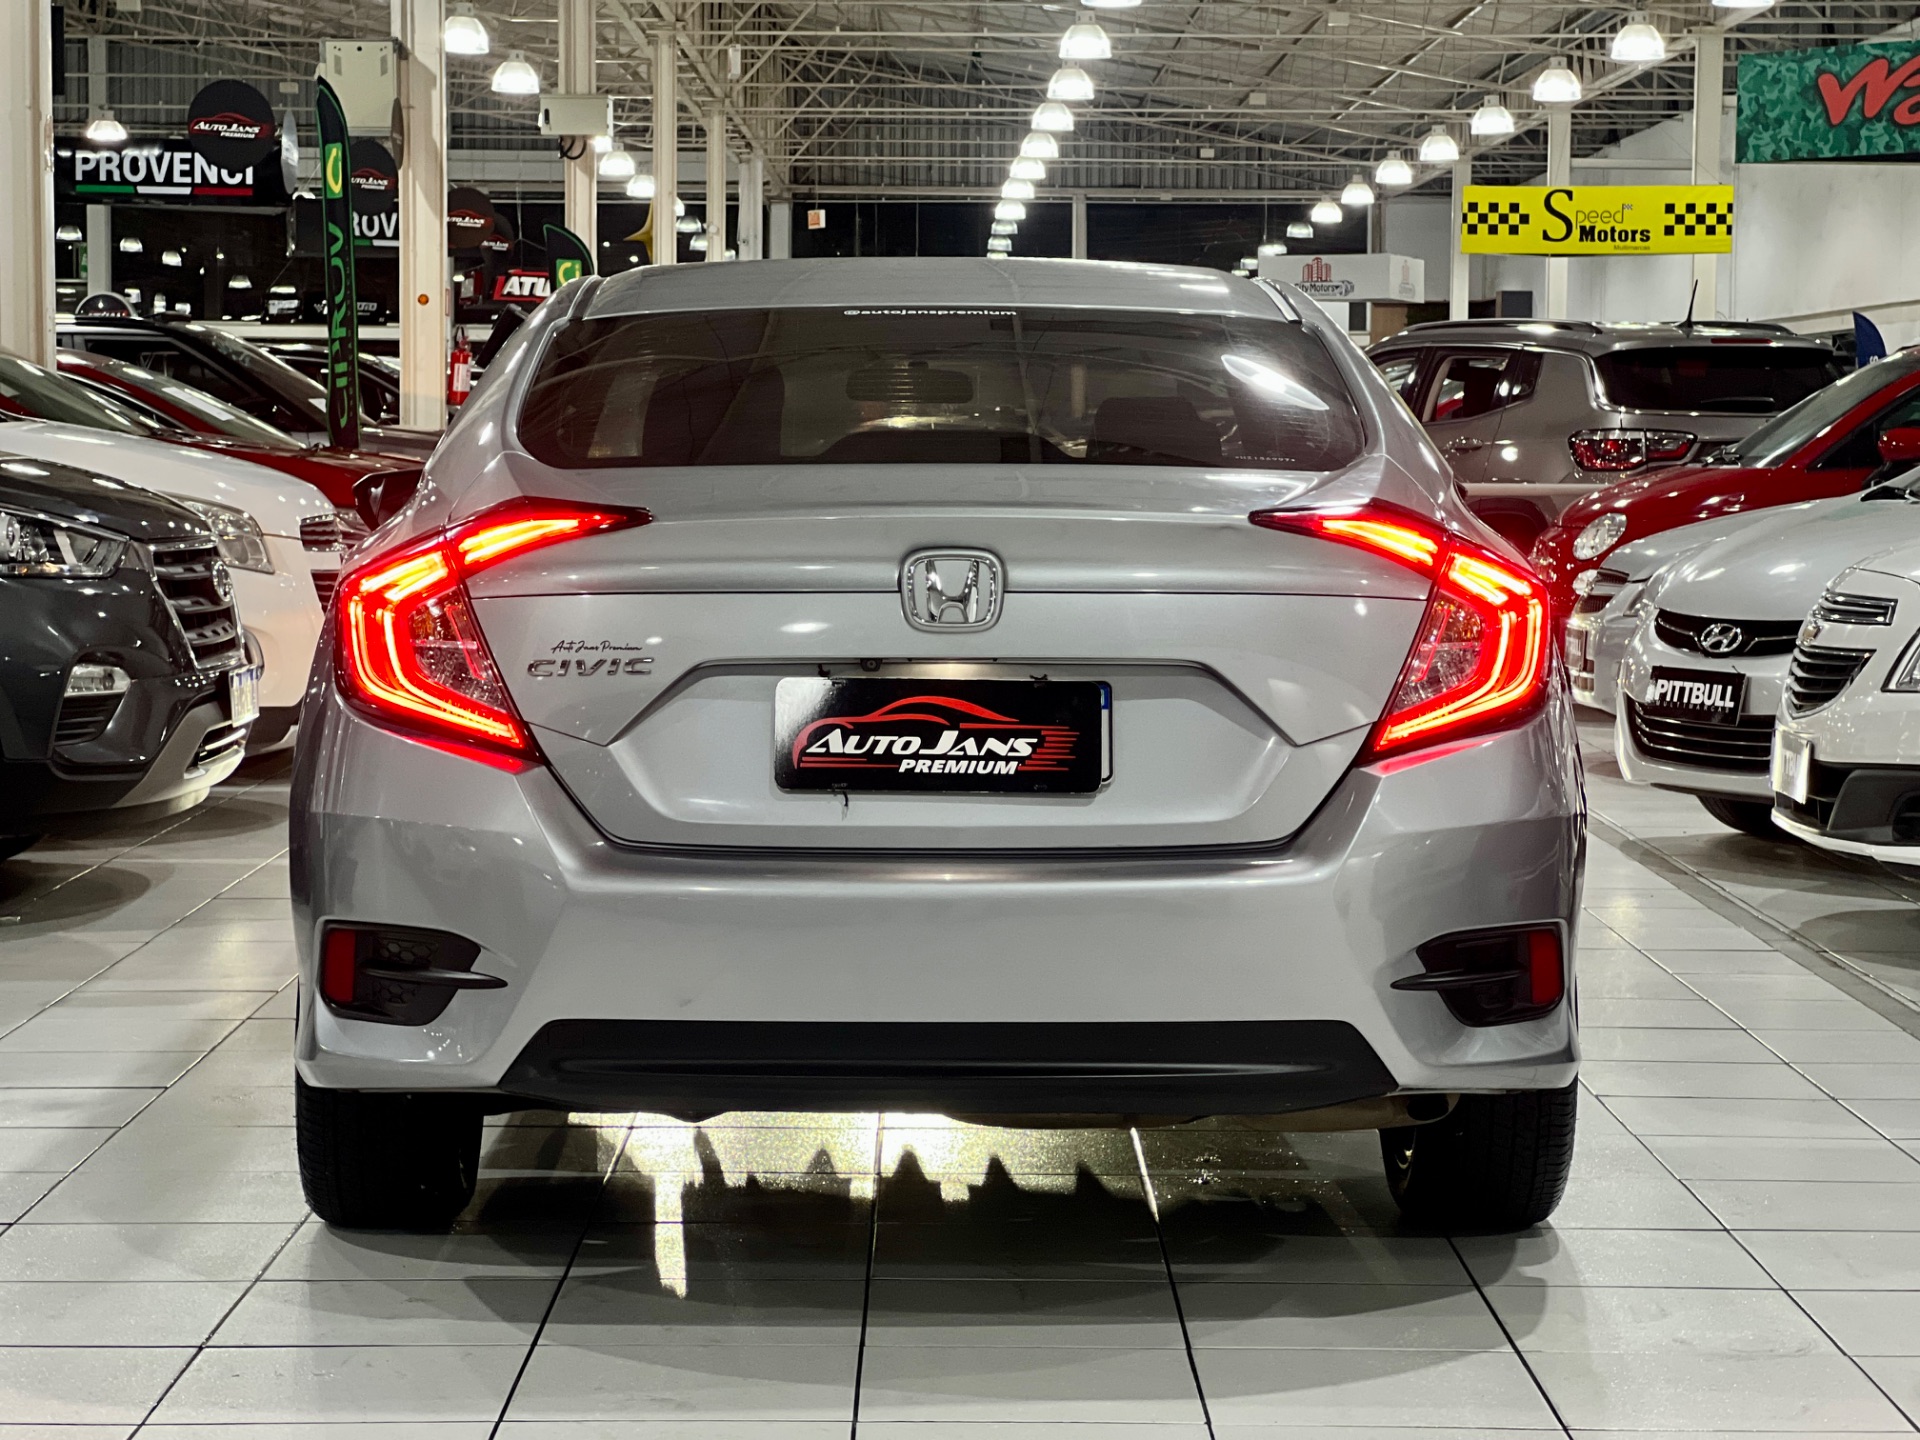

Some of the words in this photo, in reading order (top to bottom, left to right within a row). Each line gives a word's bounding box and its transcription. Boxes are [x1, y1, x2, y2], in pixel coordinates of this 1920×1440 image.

[1543, 189, 1625, 243] Speed
[1578, 225, 1651, 243] Motors
[1310, 283, 1335, 292] Motors
[600, 640, 643, 653] Premium
[527, 657, 655, 677] CIVIC
[1655, 679, 1735, 708] PITTBULL
[898, 759, 1019, 775] PREMIUM
